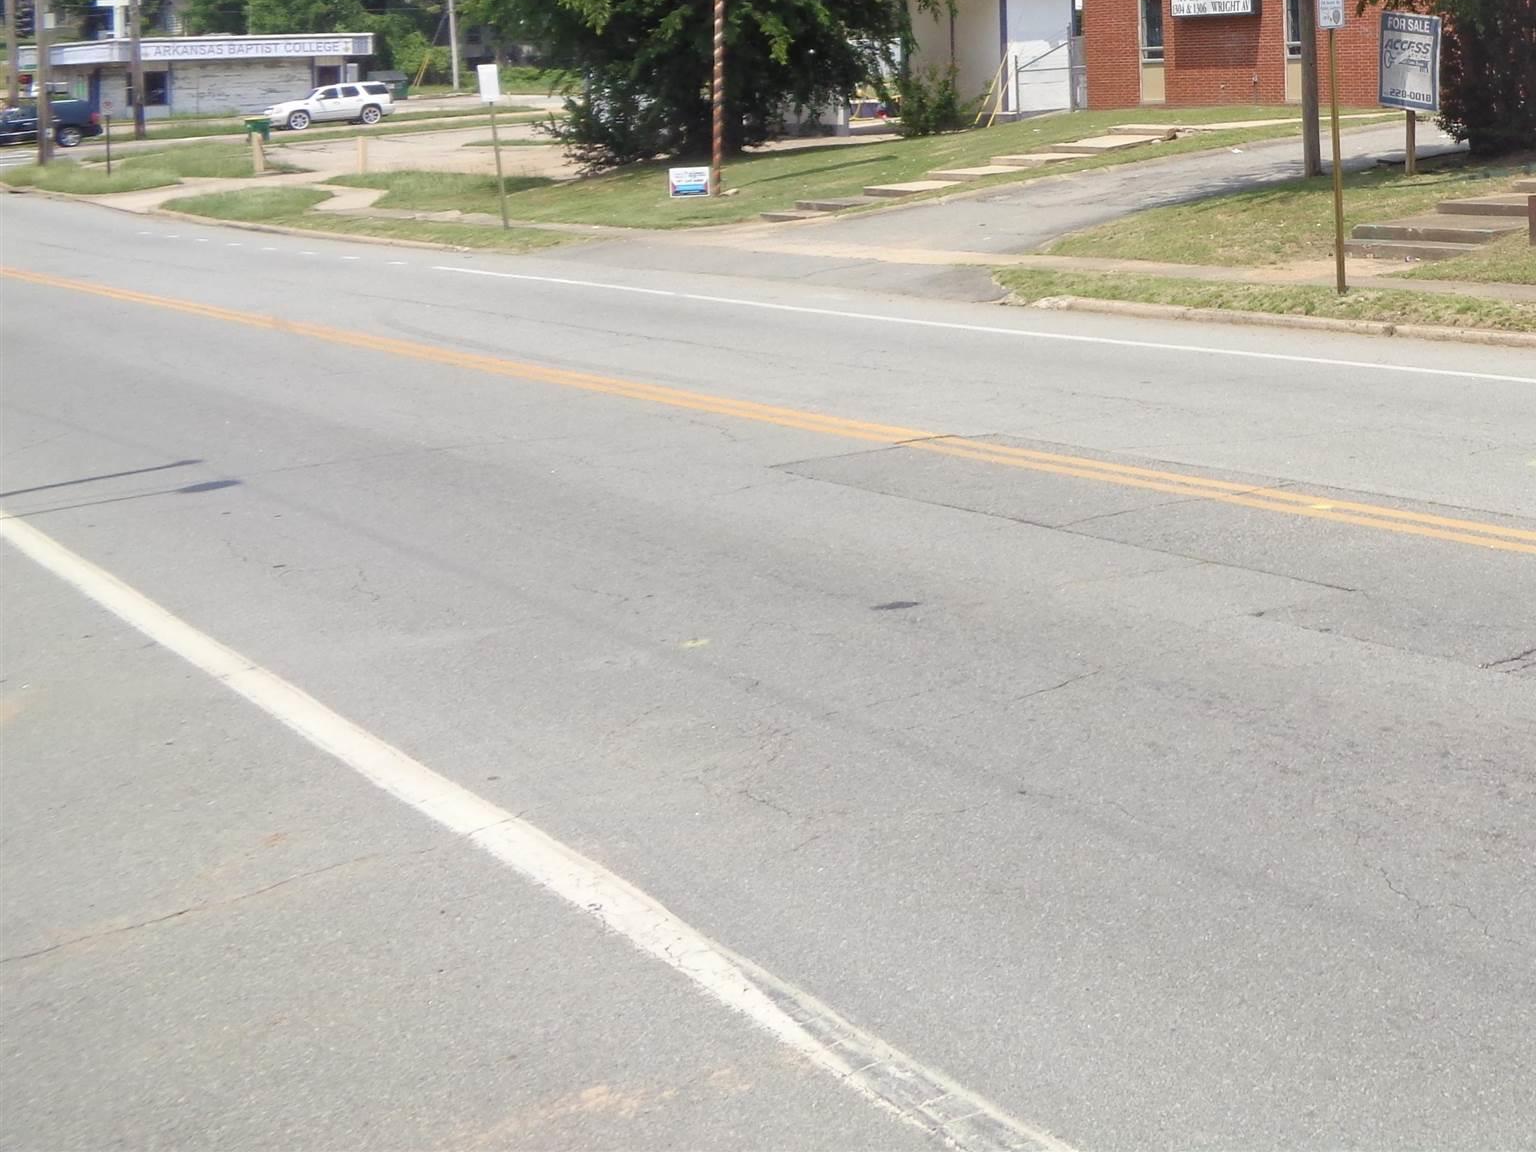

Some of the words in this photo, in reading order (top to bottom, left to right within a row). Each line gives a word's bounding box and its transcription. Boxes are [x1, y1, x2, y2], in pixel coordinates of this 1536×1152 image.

[1211, 0, 1241, 13] WRIGHT
[1388, 16, 1406, 31] FOR
[1408, 19, 1430, 33] SALE
[154, 43, 223, 57] ARKANSAS
[229, 42, 280, 55] BAPTIST
[284, 41, 339, 54] COLLEGE
[1384, 38, 1431, 55] ACCESS
